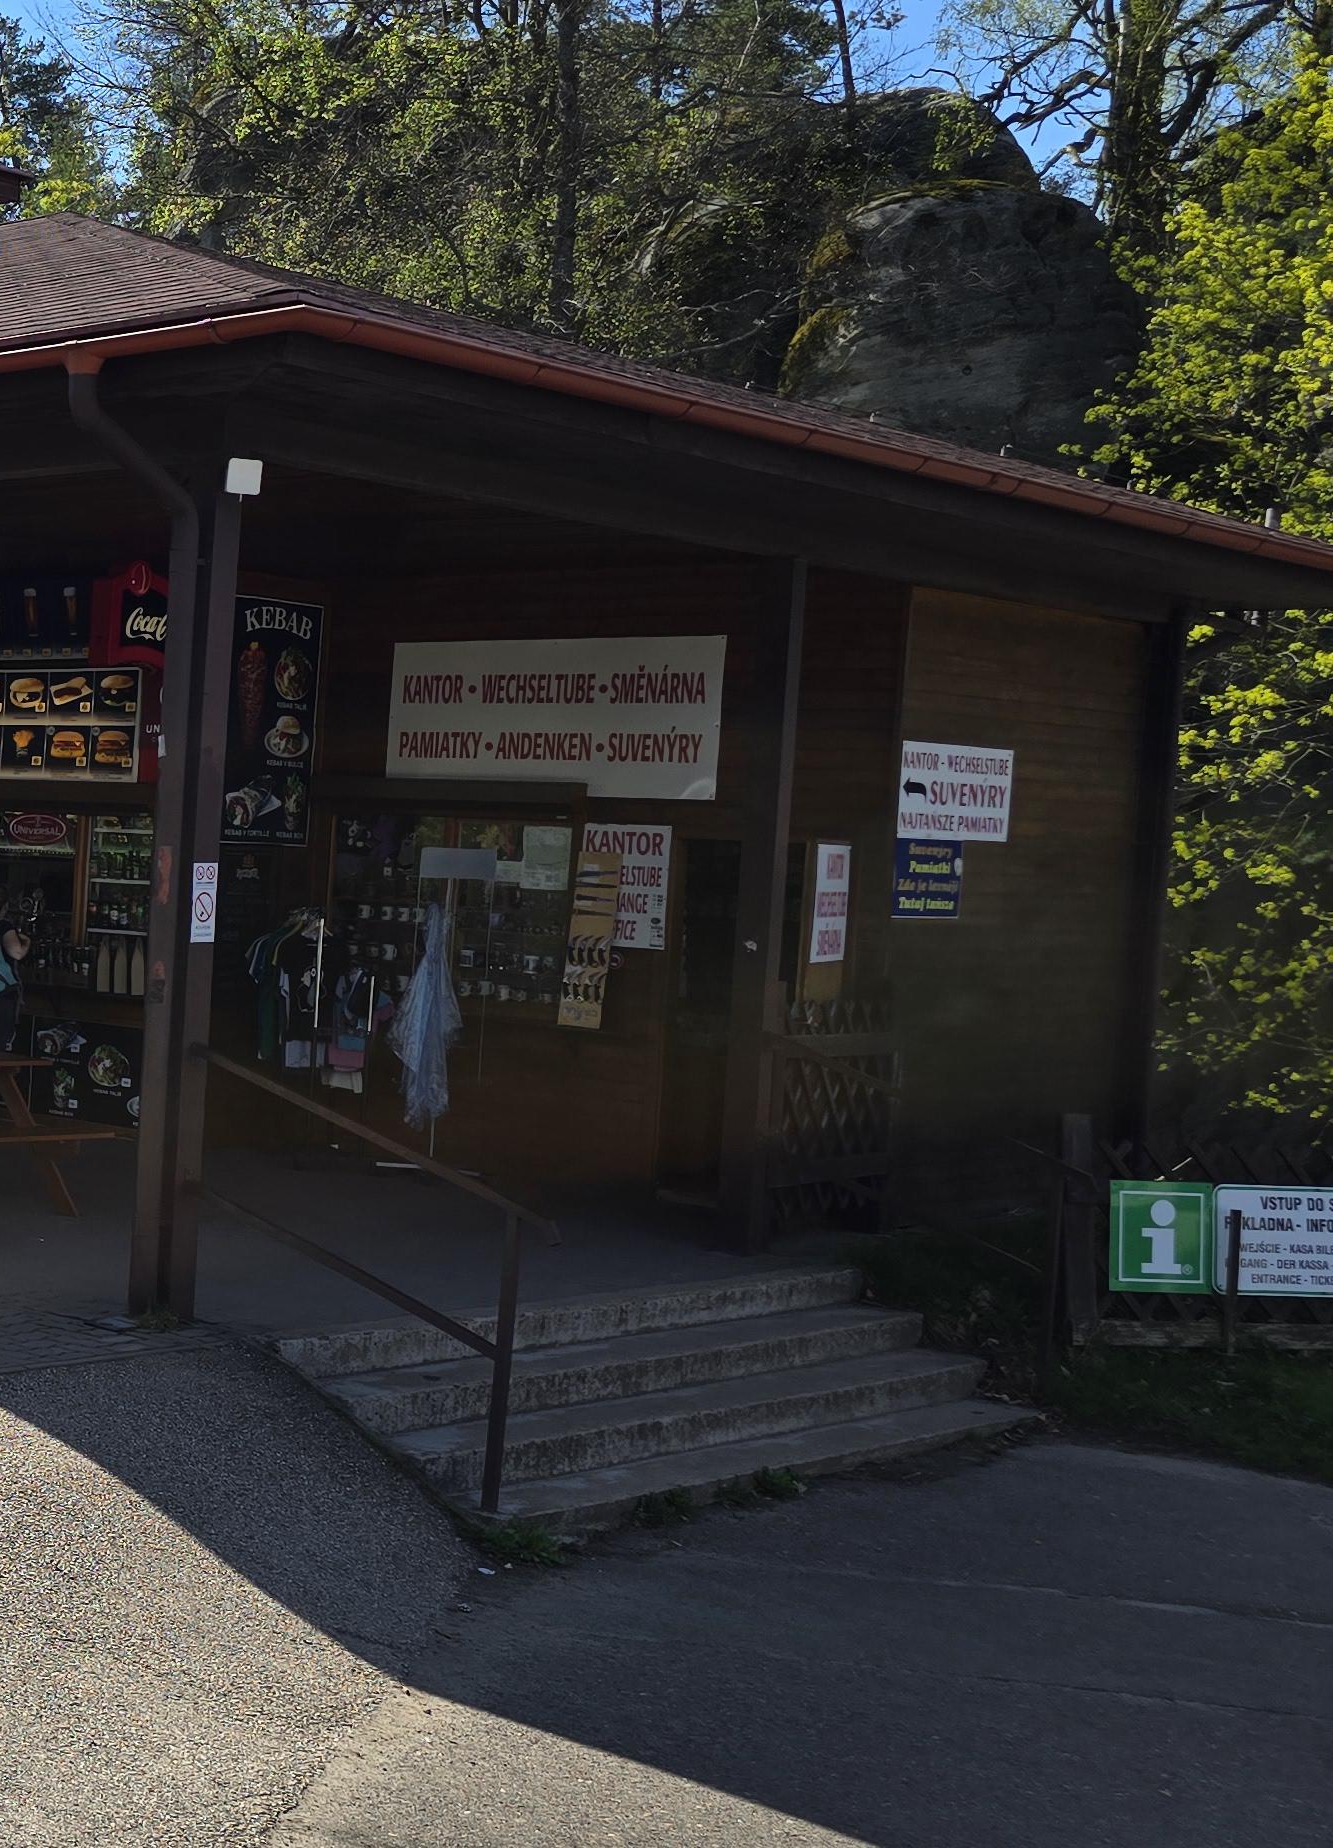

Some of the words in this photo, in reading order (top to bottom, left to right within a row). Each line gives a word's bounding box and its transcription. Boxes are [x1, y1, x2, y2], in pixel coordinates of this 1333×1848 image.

[244, 606, 313, 641] KEBAB
[402, 675, 463, 704] KANTOR
[481, 673, 596, 704] WECHSELTUBE
[609, 664, 706, 704] SMĚNÁRNA
[398, 731, 483, 759] PAMIATKY
[494, 732, 592, 761] ANDENKEN
[607, 727, 703, 763] SUVENÝRY
[902, 750, 939, 770] KANTOR
[947, 755, 1010, 777] WECHSELSTUBE
[929, 778, 1008, 809] SUVENÝRY
[13, 825, 61, 837] UNIVERSAL
[586, 829, 664, 856] KANTOR
[620, 865, 662, 887] ELSTUBE
[614, 919, 637, 940] FICE
[1260, 1196, 1301, 1211] VSTUP
[1307, 1198, 1324, 1211] DO
[1224, 1216, 1294, 1232] PKLADNA
[1289, 1243, 1314, 1254] KASA
[1277, 1259, 1296, 1269] DER
[1298, 1260, 1329, 1270] KASSA
[1251, 1273, 1302, 1285] ENTRANCE
